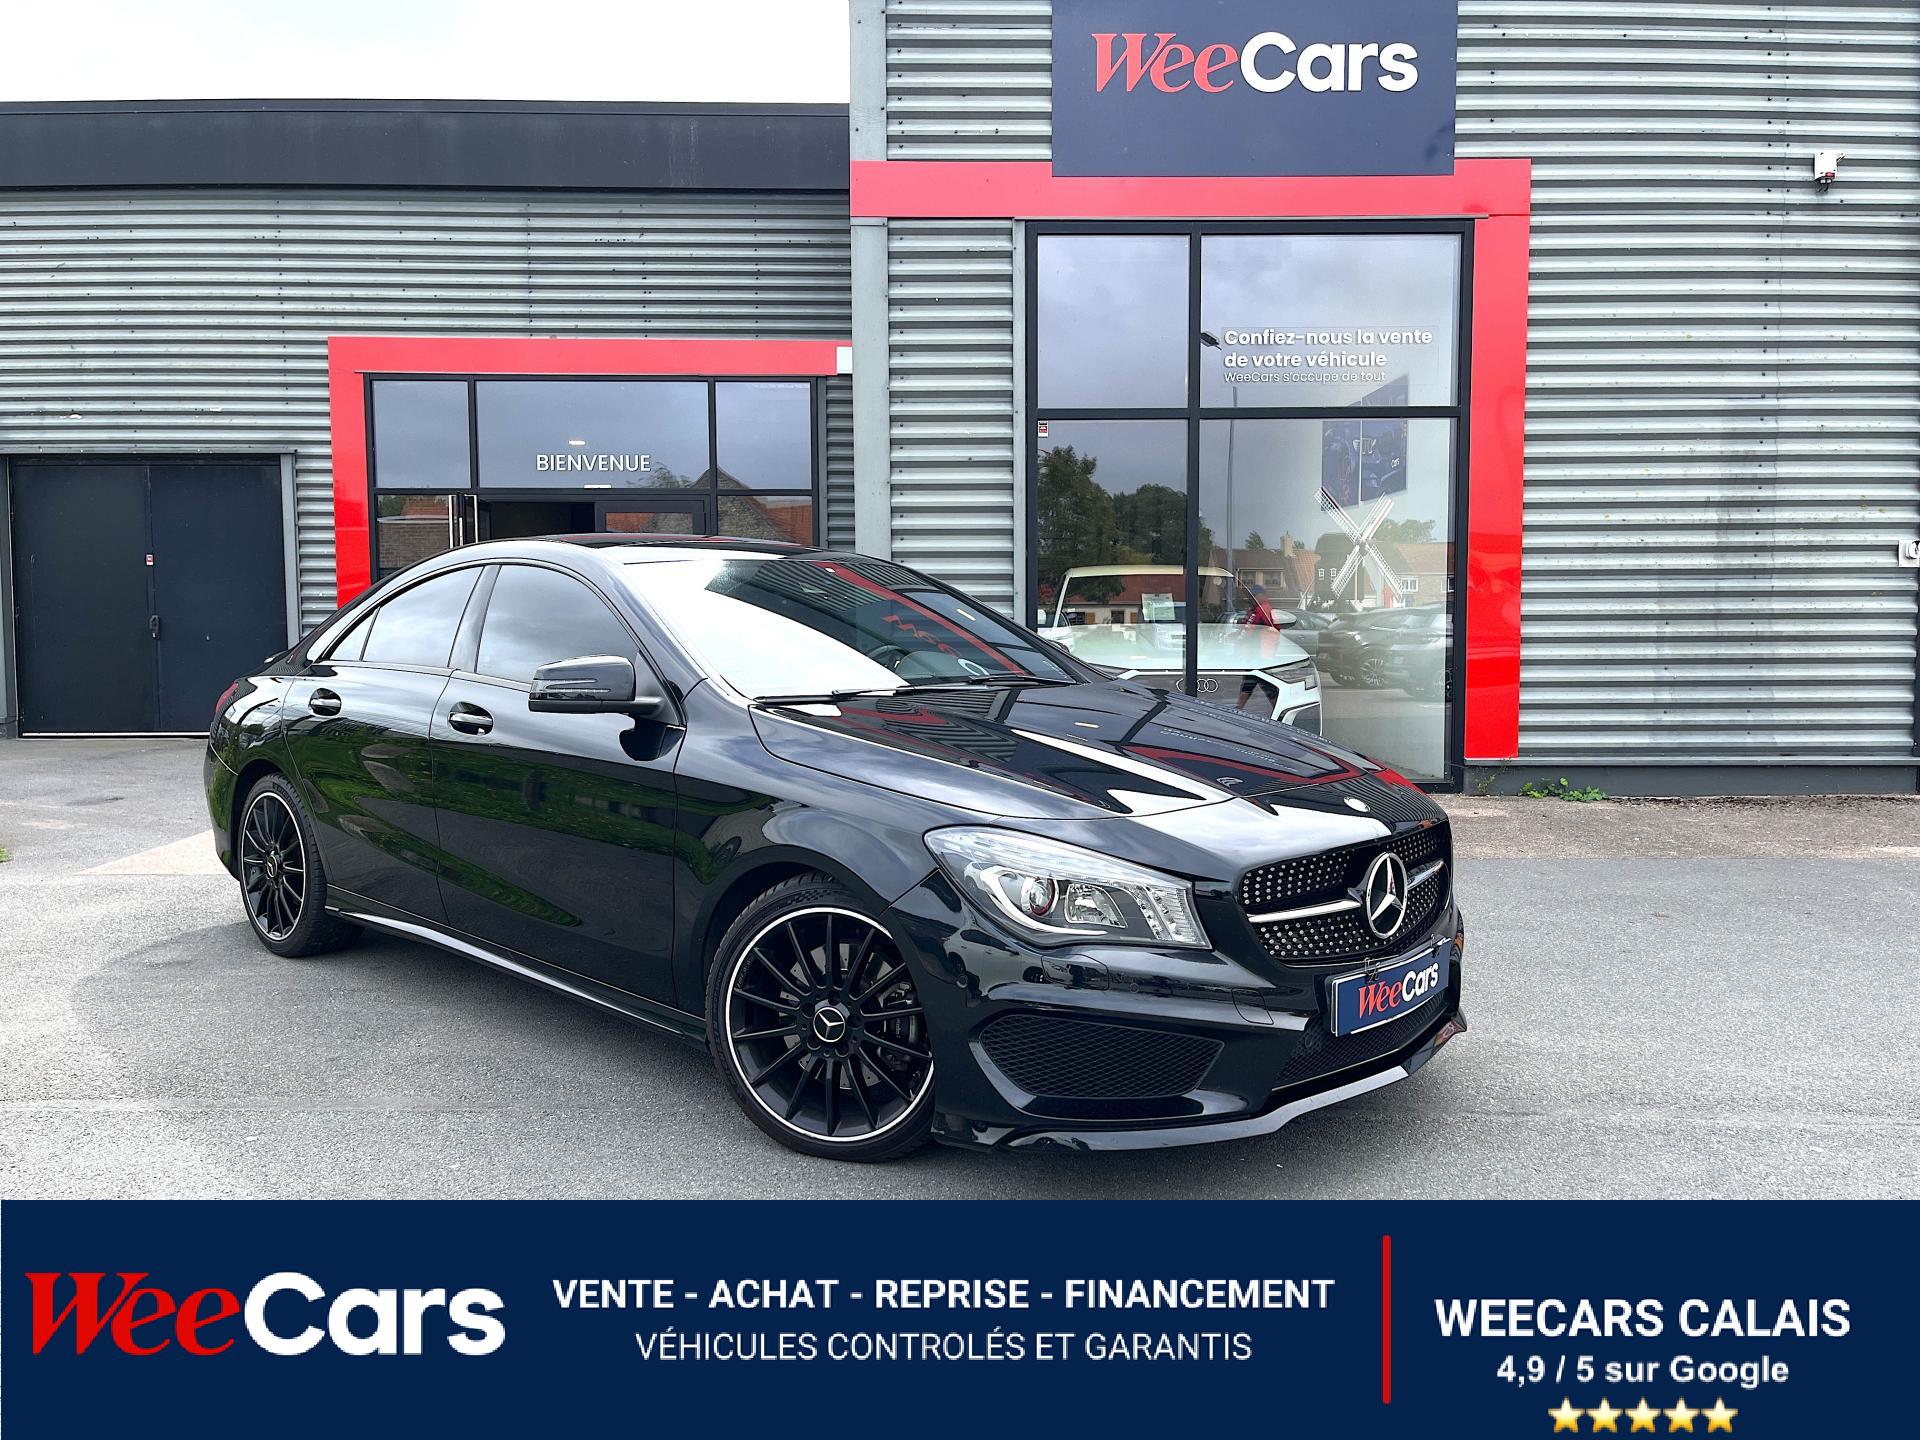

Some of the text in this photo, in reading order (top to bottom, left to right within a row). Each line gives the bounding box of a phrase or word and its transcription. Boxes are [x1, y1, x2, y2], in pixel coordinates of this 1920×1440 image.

[1091, 31, 1419, 94] WeeCars
[1224, 328, 1433, 345] Confiez-nous la vente
[1224, 351, 1388, 367] de votre véhicule
[1224, 371, 1386, 385] WeeCars s'occupe de tout
[536, 454, 651, 472] BIENVENUE
[1357, 961, 1440, 1020] WeeCars
